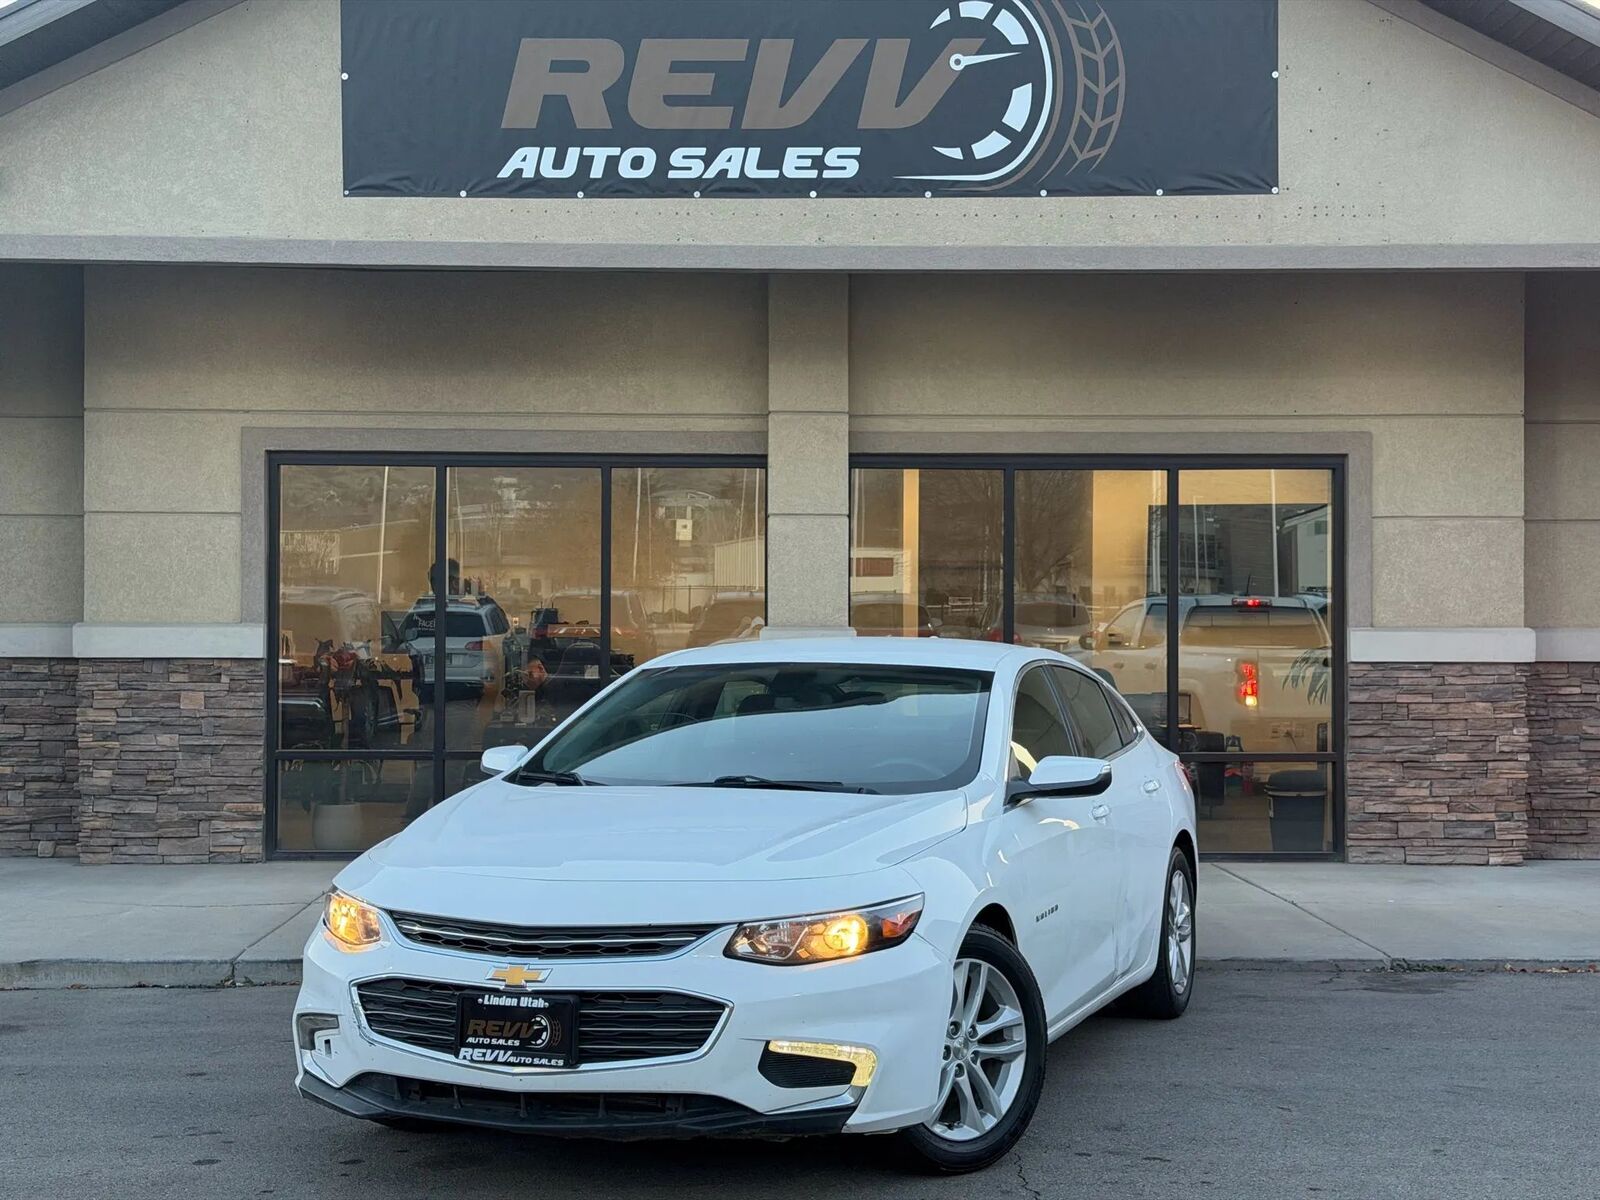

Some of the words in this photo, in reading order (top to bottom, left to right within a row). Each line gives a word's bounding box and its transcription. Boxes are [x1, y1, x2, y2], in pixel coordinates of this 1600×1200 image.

[500, 38, 987, 129] REVV
[497, 147, 657, 179] AUTO
[667, 147, 861, 179] SALES
[484, 994, 517, 1006] Lindon
[520, 997, 545, 1008] Utah
[467, 1020, 535, 1038] REVV
[491, 1038, 520, 1046] SALES
[459, 1047, 513, 1062] REVV
[533, 1058, 564, 1066] SALES
